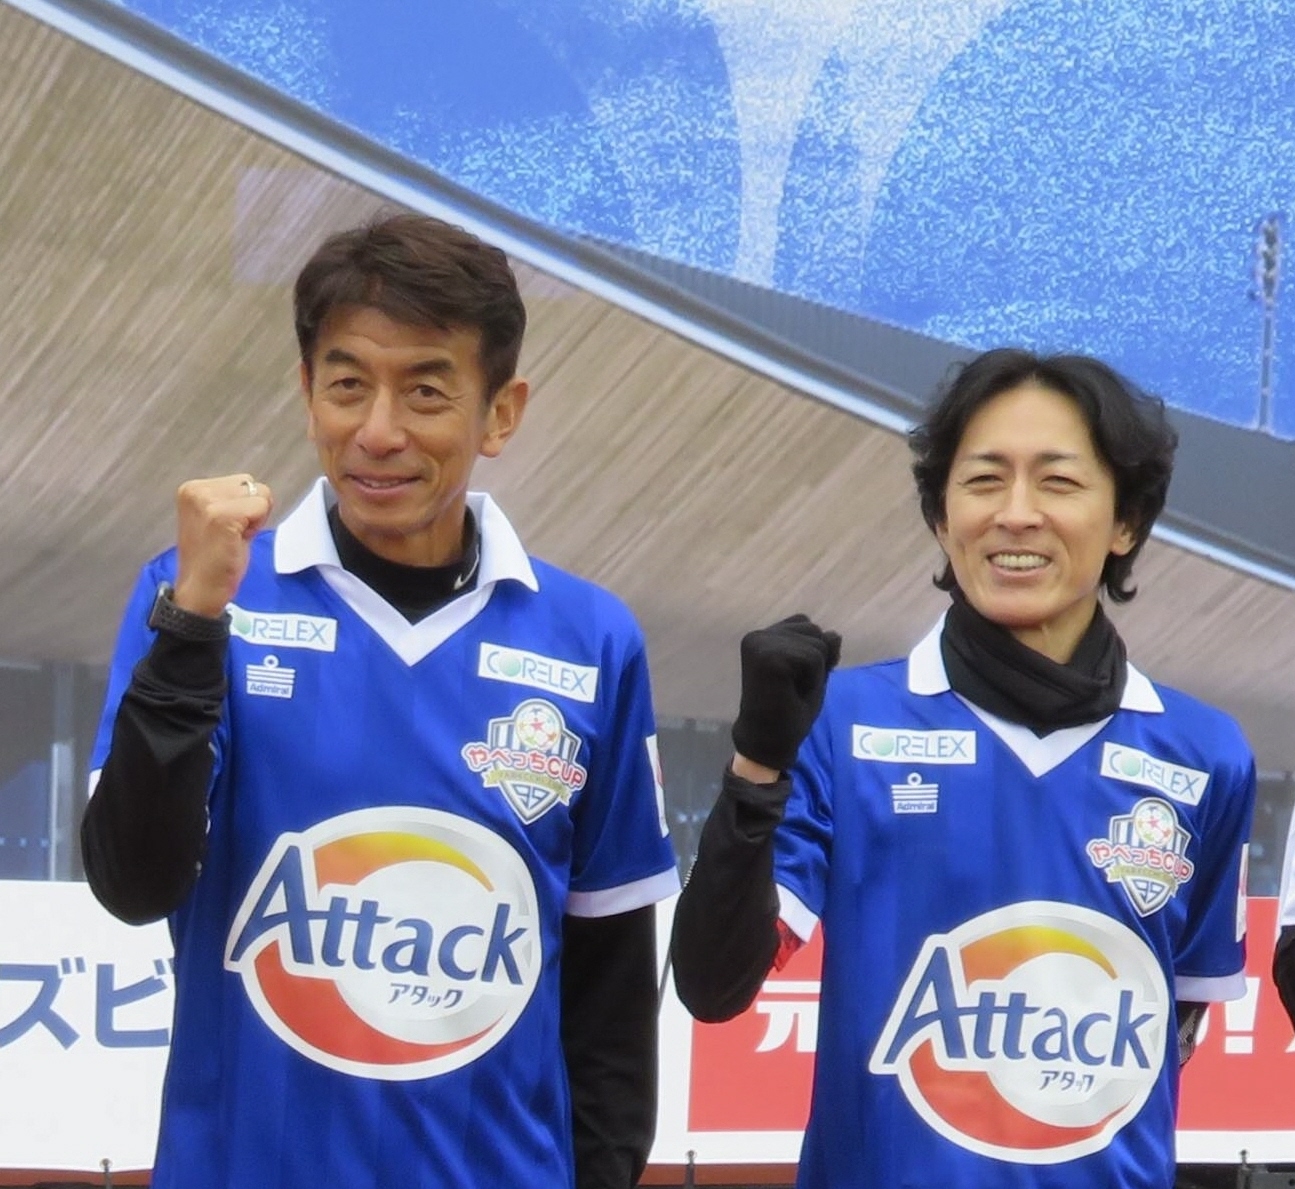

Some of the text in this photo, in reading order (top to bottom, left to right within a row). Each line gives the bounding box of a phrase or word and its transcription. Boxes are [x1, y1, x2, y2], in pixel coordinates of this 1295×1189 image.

[230, 608, 327, 645] ORELEX
[486, 651, 590, 696] CORELEX
[859, 732, 968, 758] CORELEX
[230, 845, 529, 985] Attack
[387, 982, 463, 1009] アタック
[882, 946, 1156, 1069] Attack
